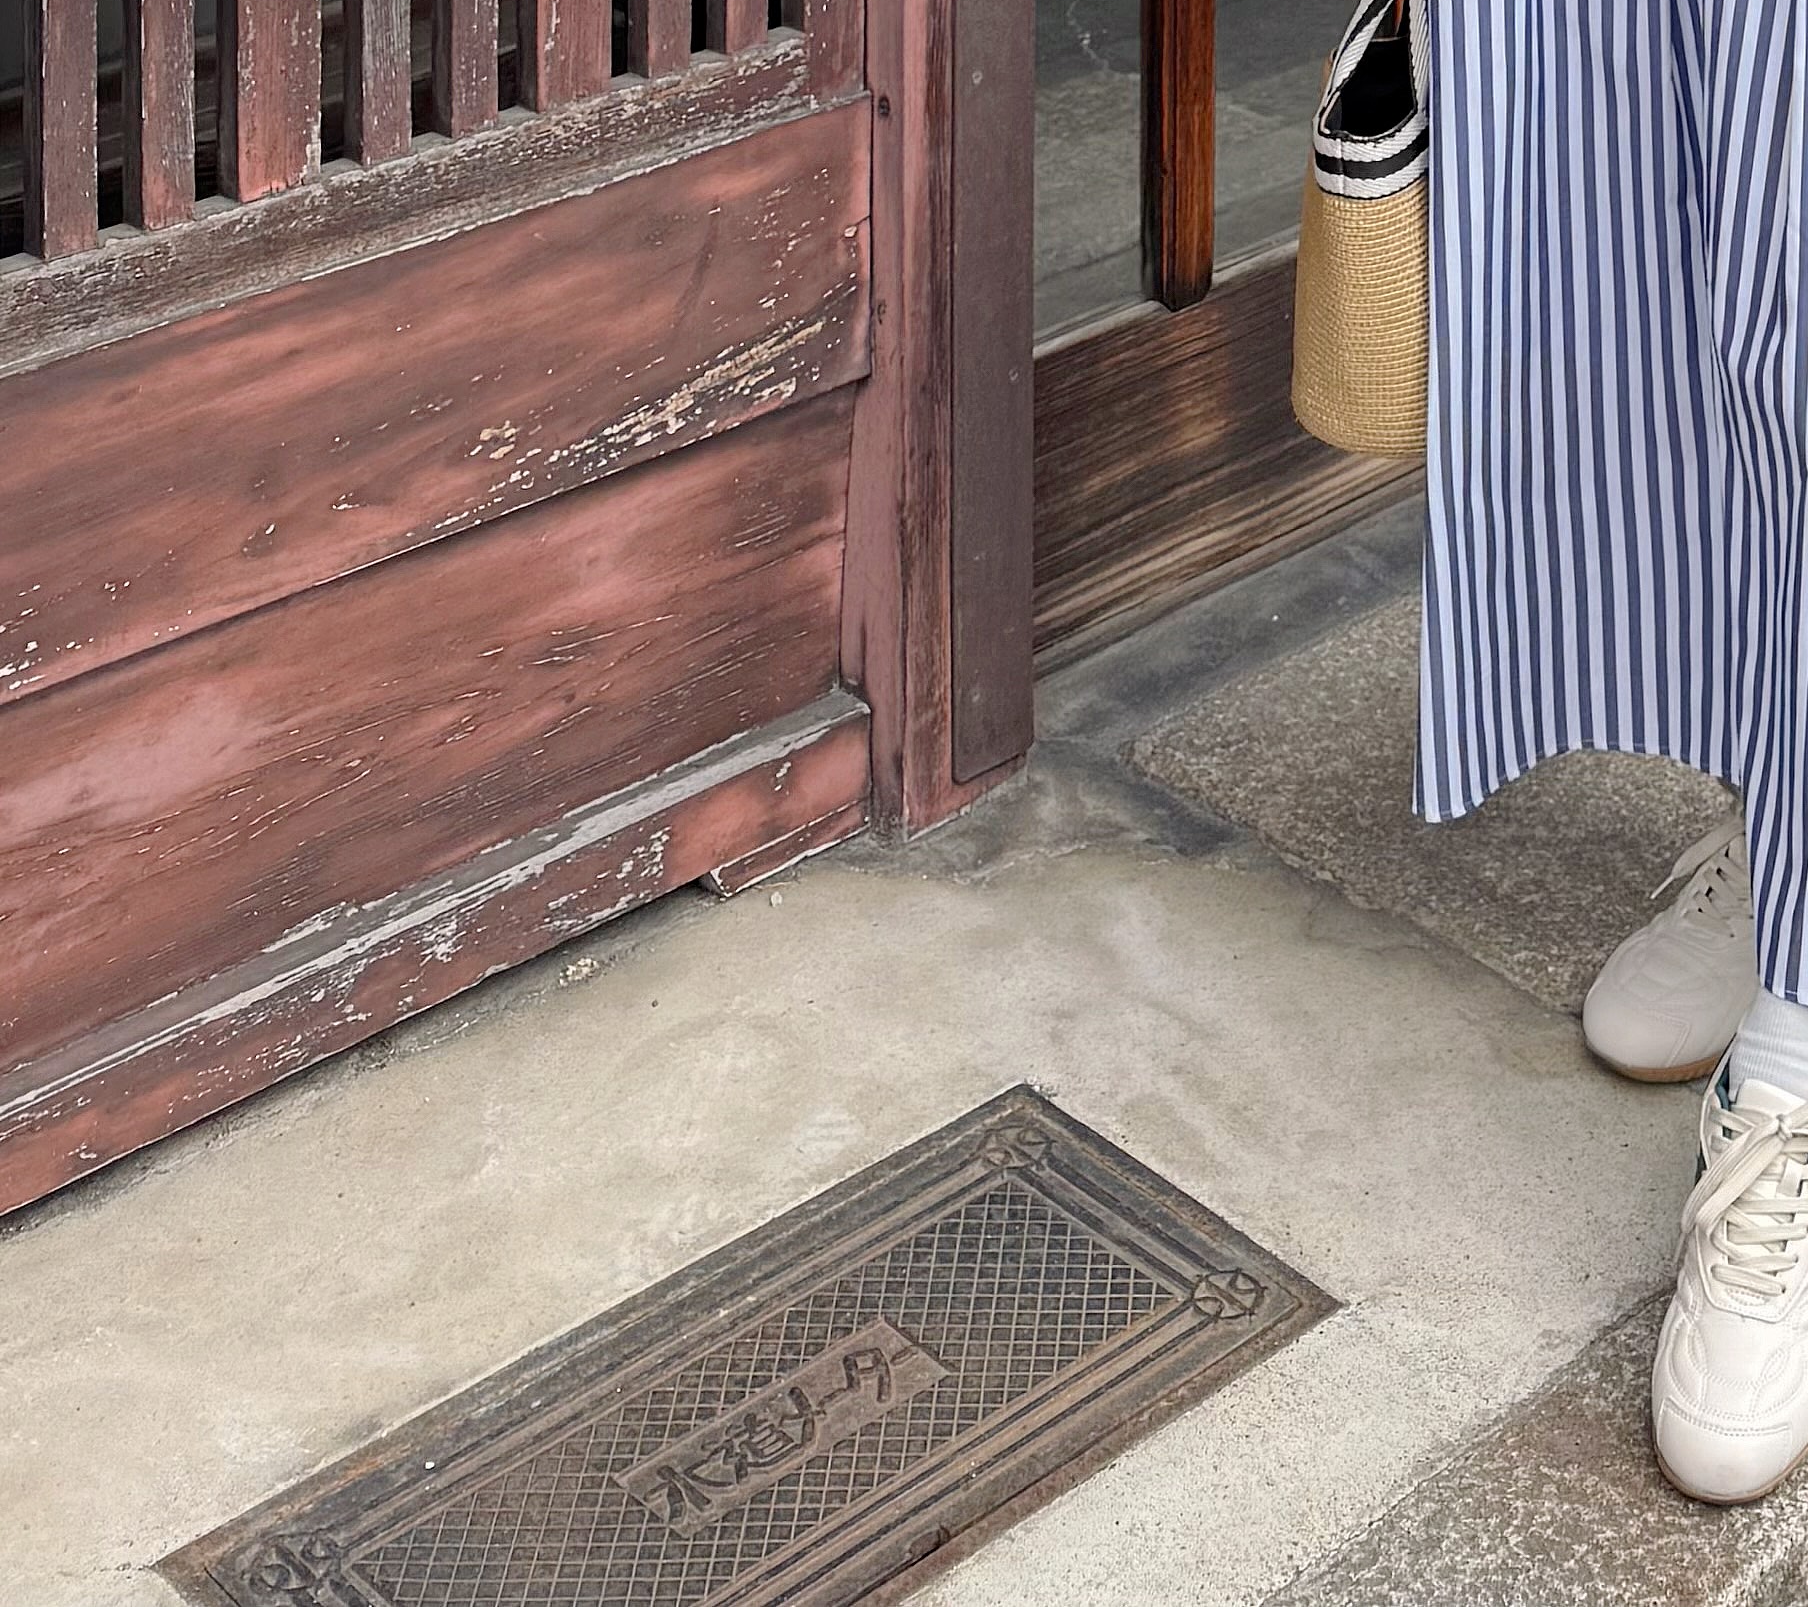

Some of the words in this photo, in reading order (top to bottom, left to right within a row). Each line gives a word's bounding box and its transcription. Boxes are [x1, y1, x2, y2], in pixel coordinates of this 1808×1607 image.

[643, 1345, 918, 1524] 水道メーター
